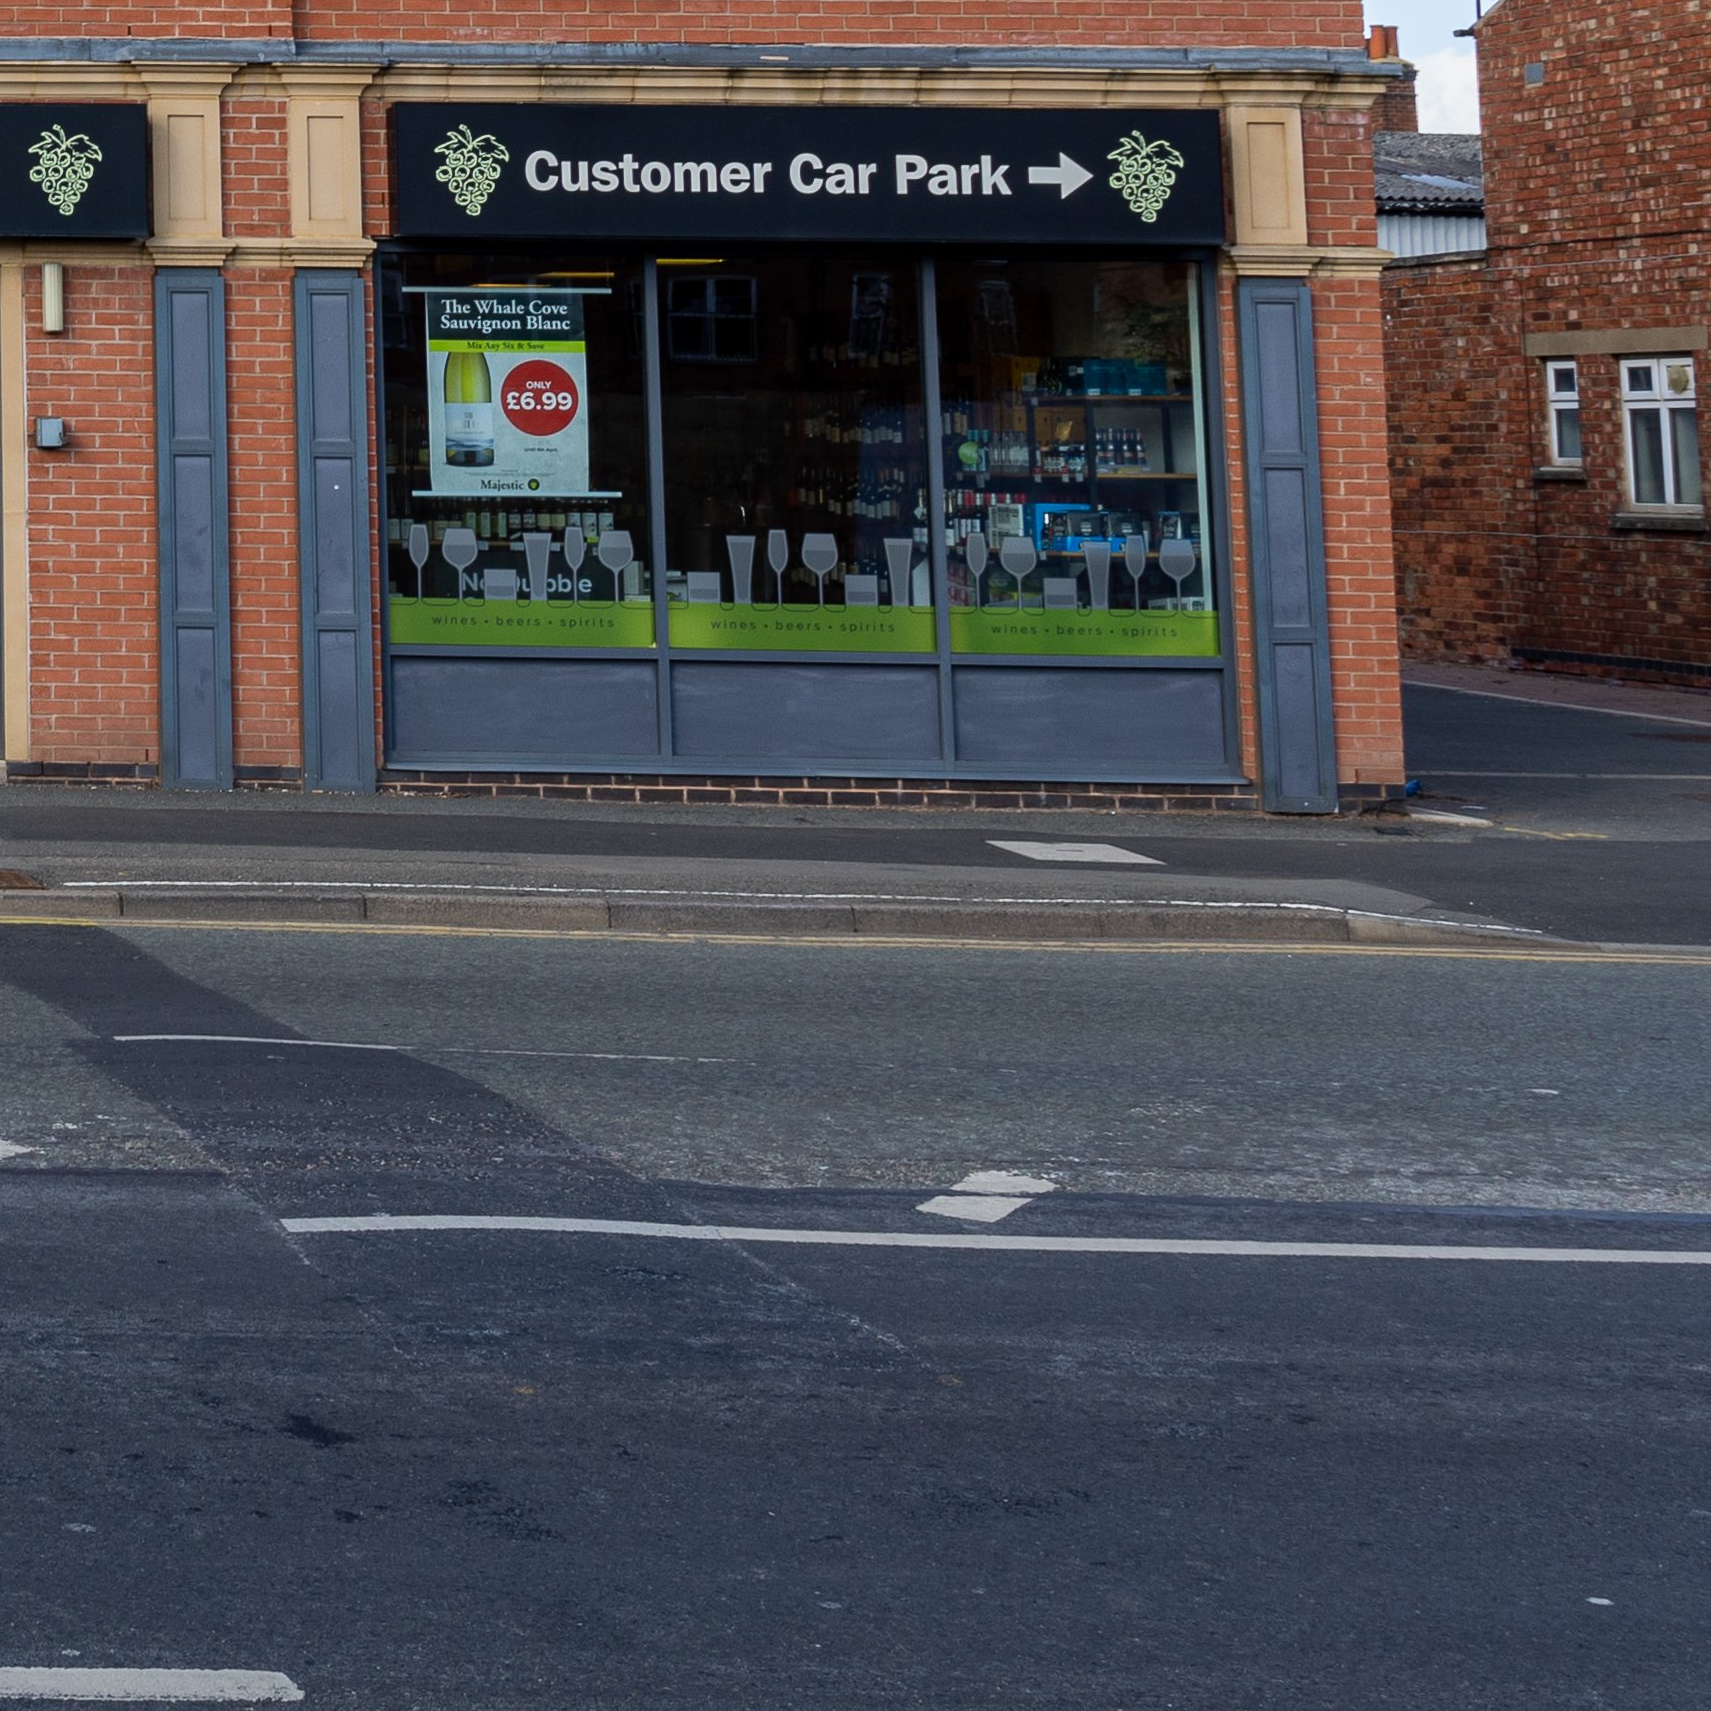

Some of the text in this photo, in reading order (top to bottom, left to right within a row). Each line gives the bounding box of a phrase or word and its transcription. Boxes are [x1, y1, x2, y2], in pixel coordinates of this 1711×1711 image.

[524, 150, 1012, 196] Customer Car Park
[440, 299, 568, 315] The Whale Cove
[440, 315, 571, 334] Sauvignon Blanc
[466, 342, 482, 350] Mix
[484, 342, 500, 351] Any
[503, 342, 515, 350] Six
[517, 342, 524, 350] &
[525, 380, 552, 390] ONLY
[506, 391, 573, 411] £6.99
[480, 480, 525, 492] Majestic
[432, 615, 614, 630] wines beers spirits
[711, 619, 895, 634] wines beers spirits
[991, 624, 1178, 638] wines beers spirits
